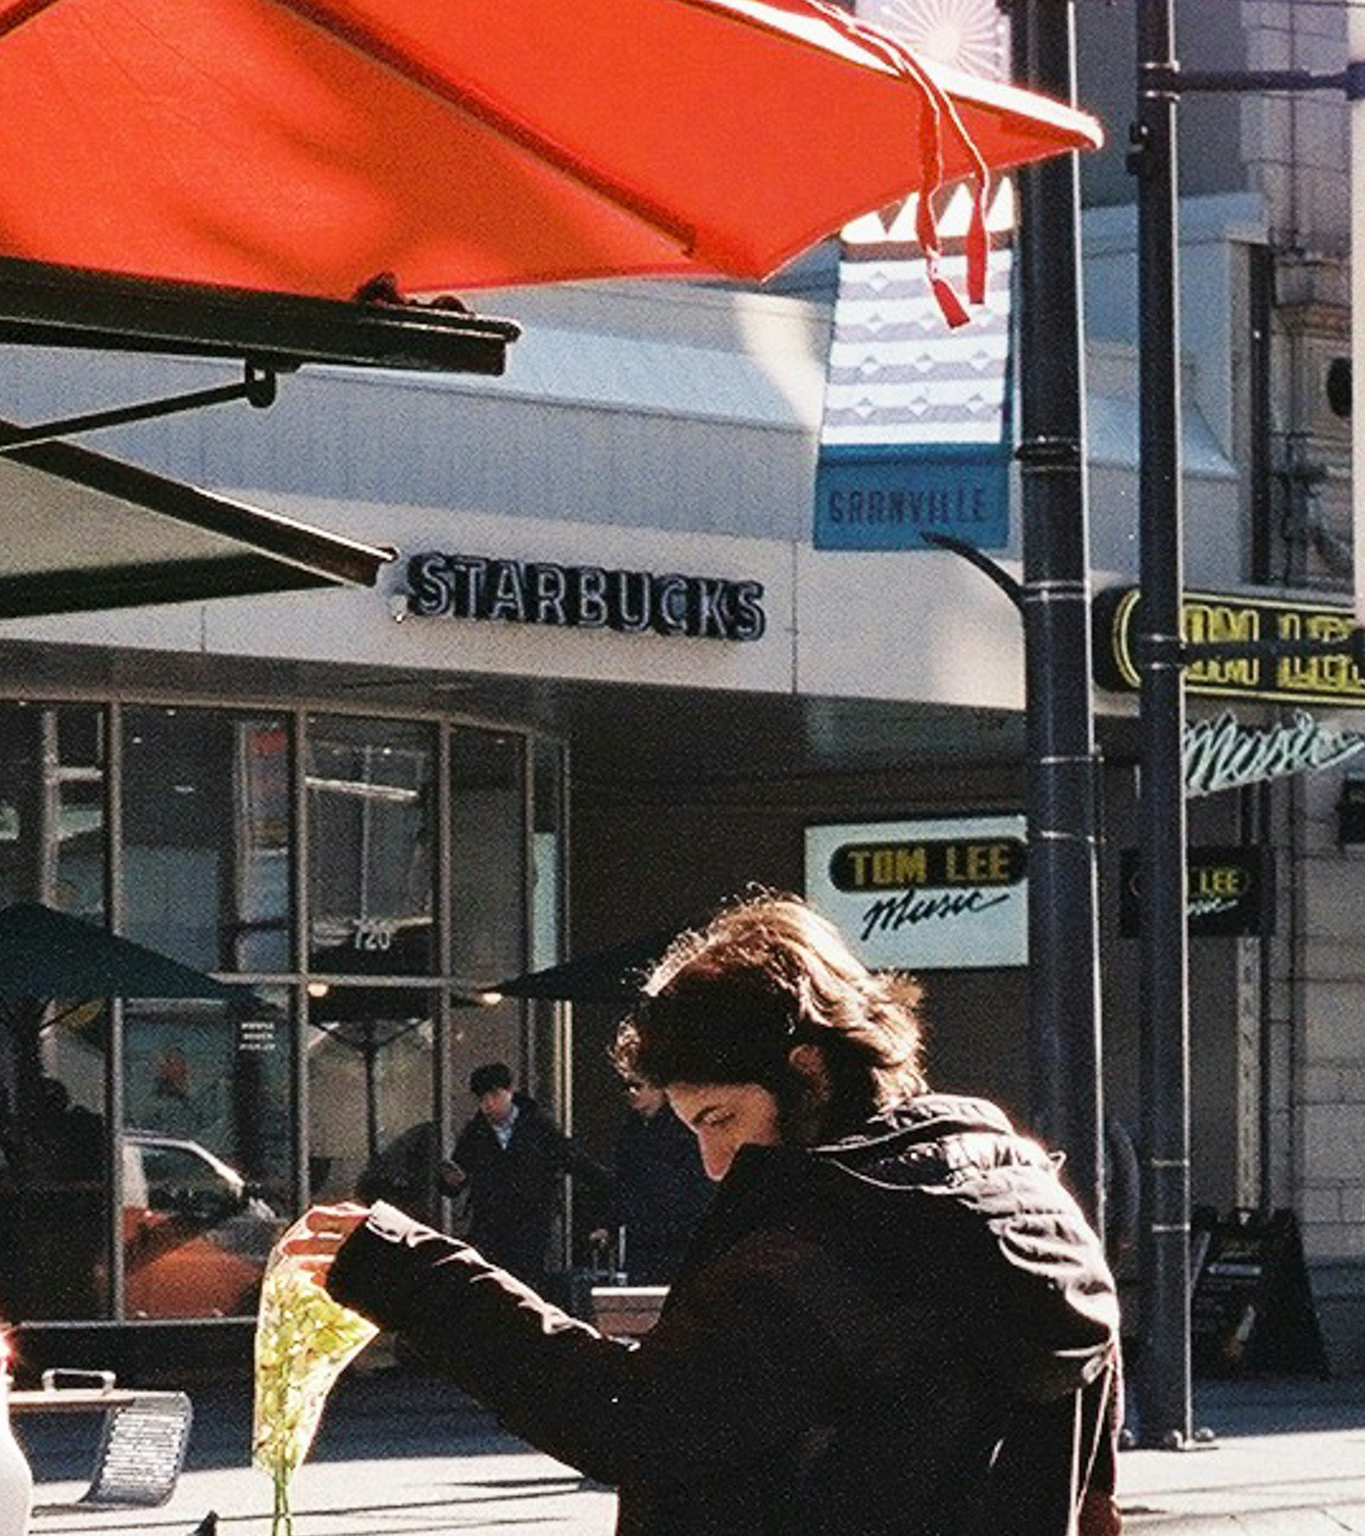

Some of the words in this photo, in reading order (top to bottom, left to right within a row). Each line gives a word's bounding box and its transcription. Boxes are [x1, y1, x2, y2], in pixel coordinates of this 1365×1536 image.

[828, 485, 986, 525] GRANVILLE
[408, 551, 767, 641] STARBUCKS
[848, 847, 927, 887] TOM
[945, 843, 1011, 882] LEE
[860, 886, 1011, 941] Music
